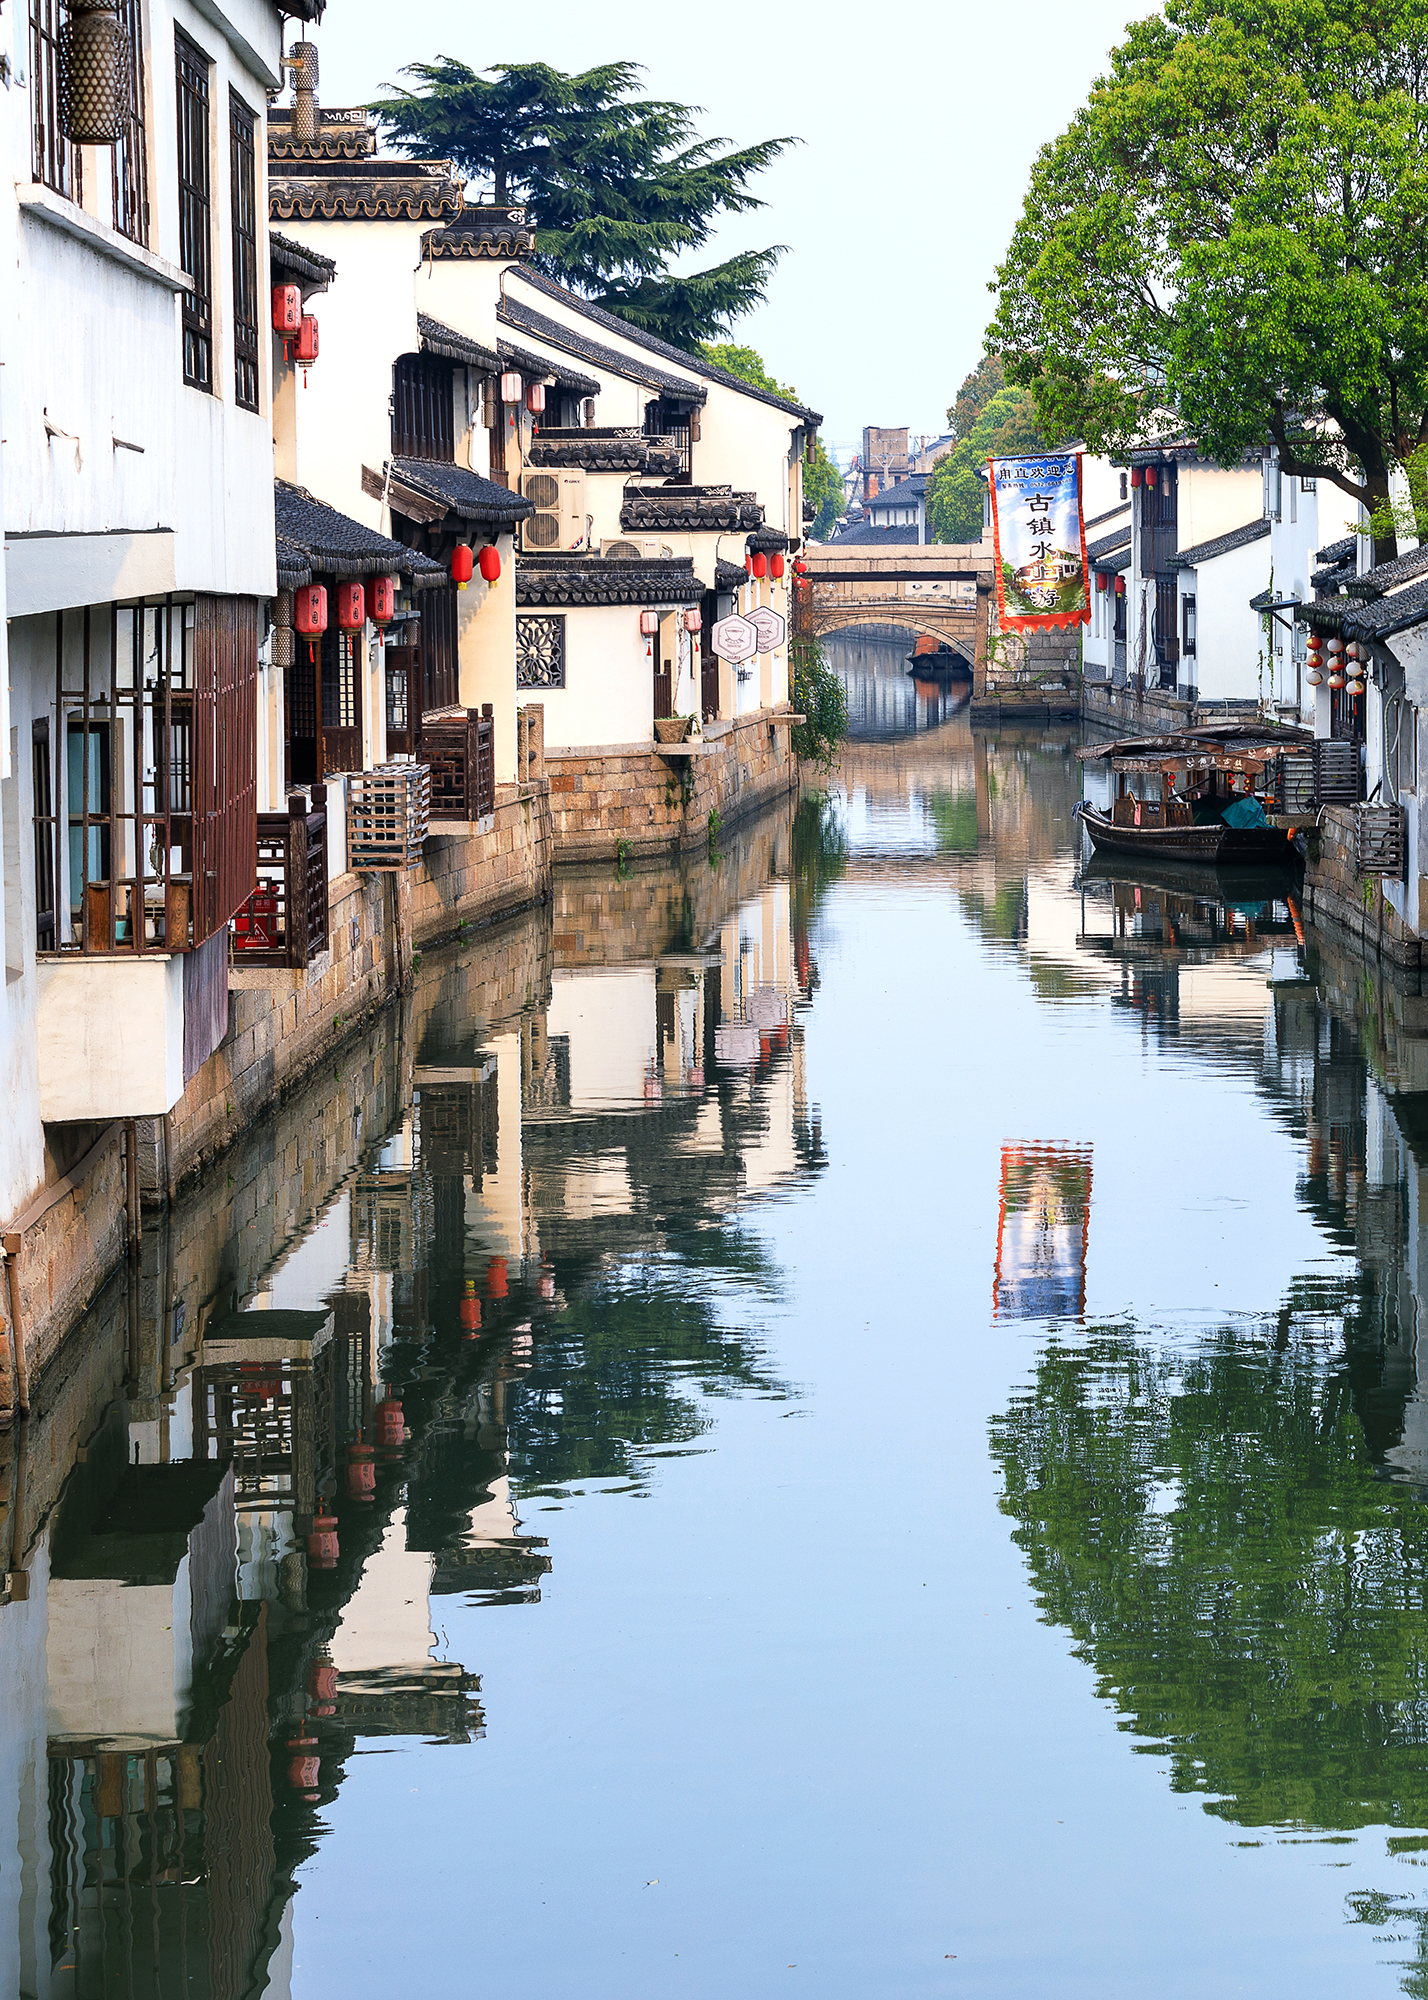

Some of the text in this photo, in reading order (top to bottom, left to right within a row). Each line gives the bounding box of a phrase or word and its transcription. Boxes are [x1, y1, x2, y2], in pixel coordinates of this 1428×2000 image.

[1025, 493, 1061, 608] 古镇水上游
